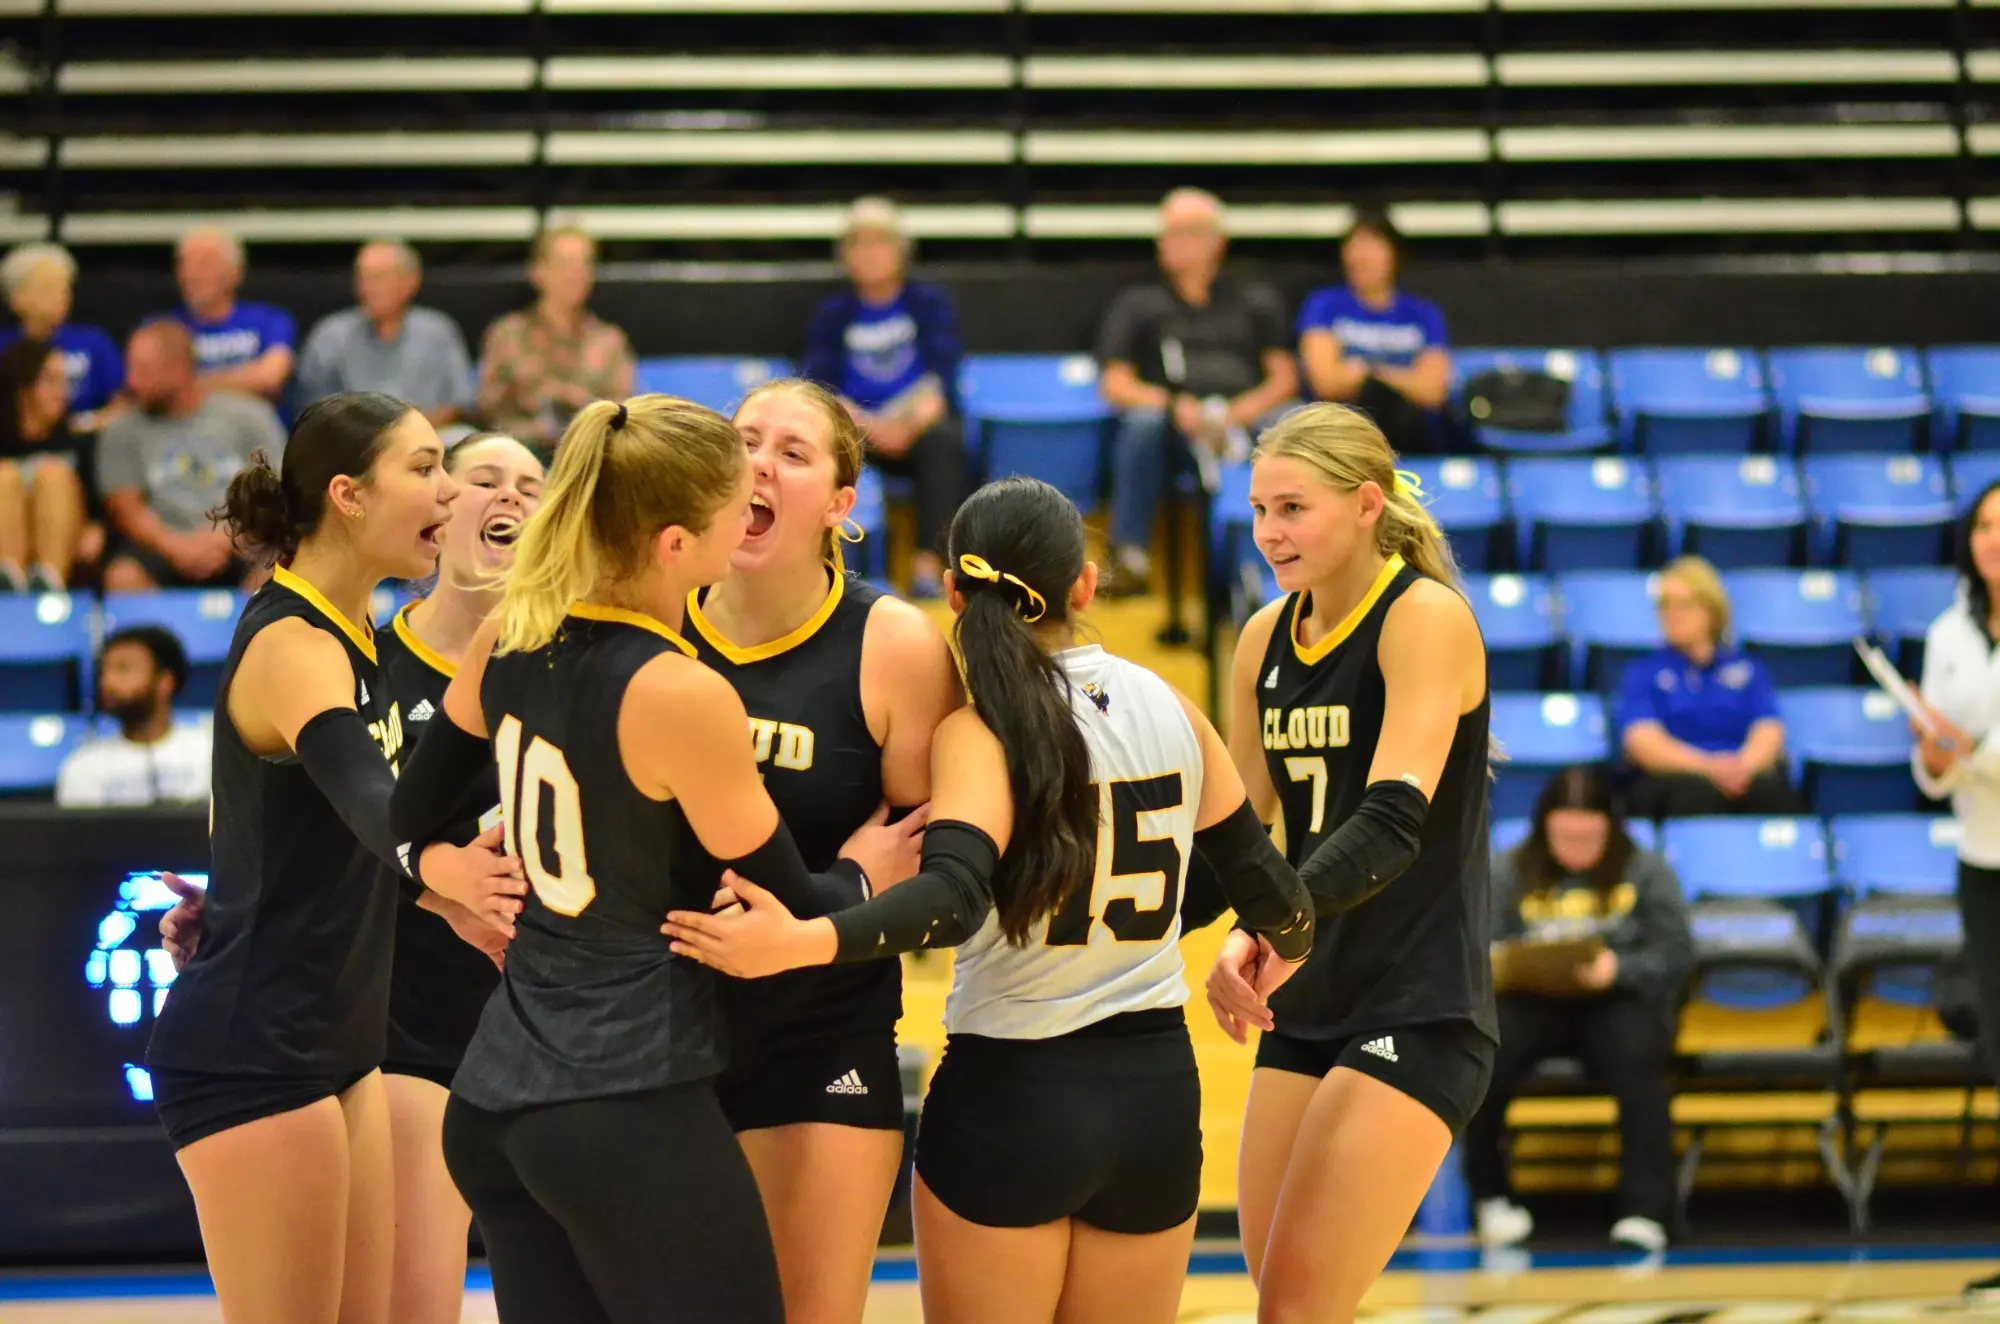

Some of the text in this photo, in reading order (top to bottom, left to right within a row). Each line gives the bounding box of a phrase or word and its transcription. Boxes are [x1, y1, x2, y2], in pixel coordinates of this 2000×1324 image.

[1263, 705, 1350, 750] CLOUD
[495, 713, 597, 918] 10
[1283, 756, 1329, 833] 7
[1360, 1043, 1399, 1062] adidas
[826, 1084, 868, 1095] adidas
